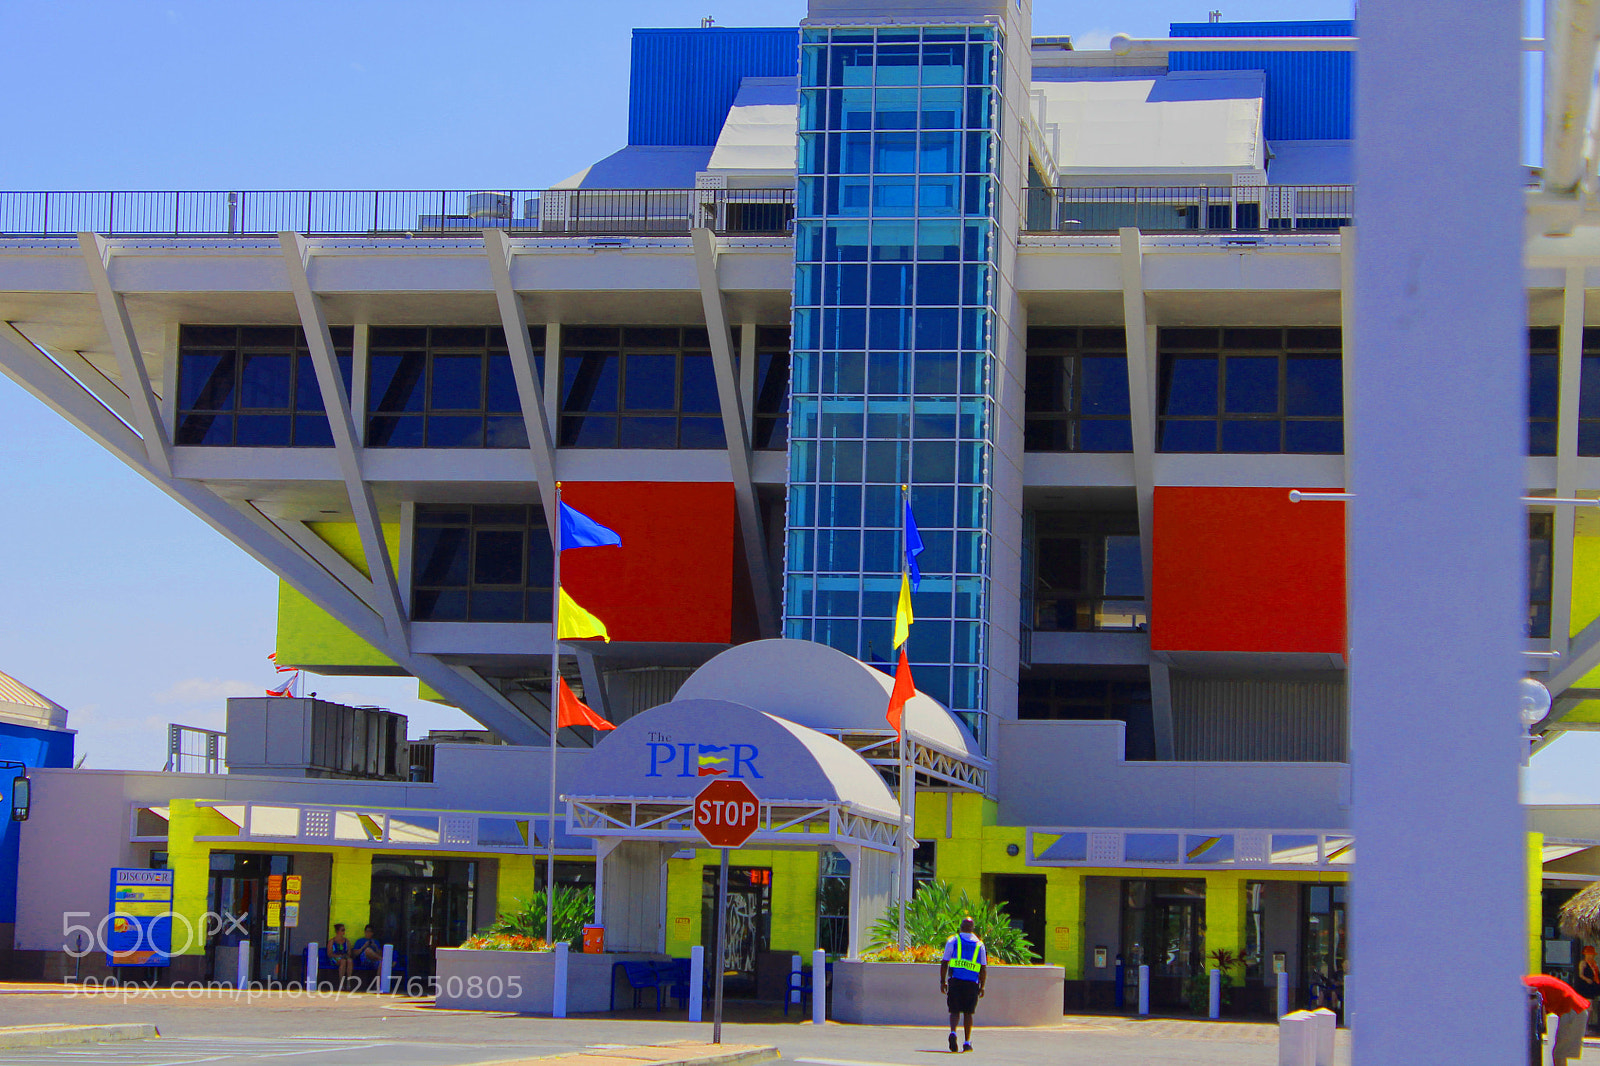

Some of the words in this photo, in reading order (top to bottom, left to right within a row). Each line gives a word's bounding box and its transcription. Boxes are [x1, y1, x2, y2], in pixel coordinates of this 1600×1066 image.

[648, 732, 672, 742] The
[645, 743, 764, 778] PIER
[698, 800, 756, 826] STOP
[119, 871, 168, 881] DISCOVER
[954, 959, 977, 970] SECURITY
